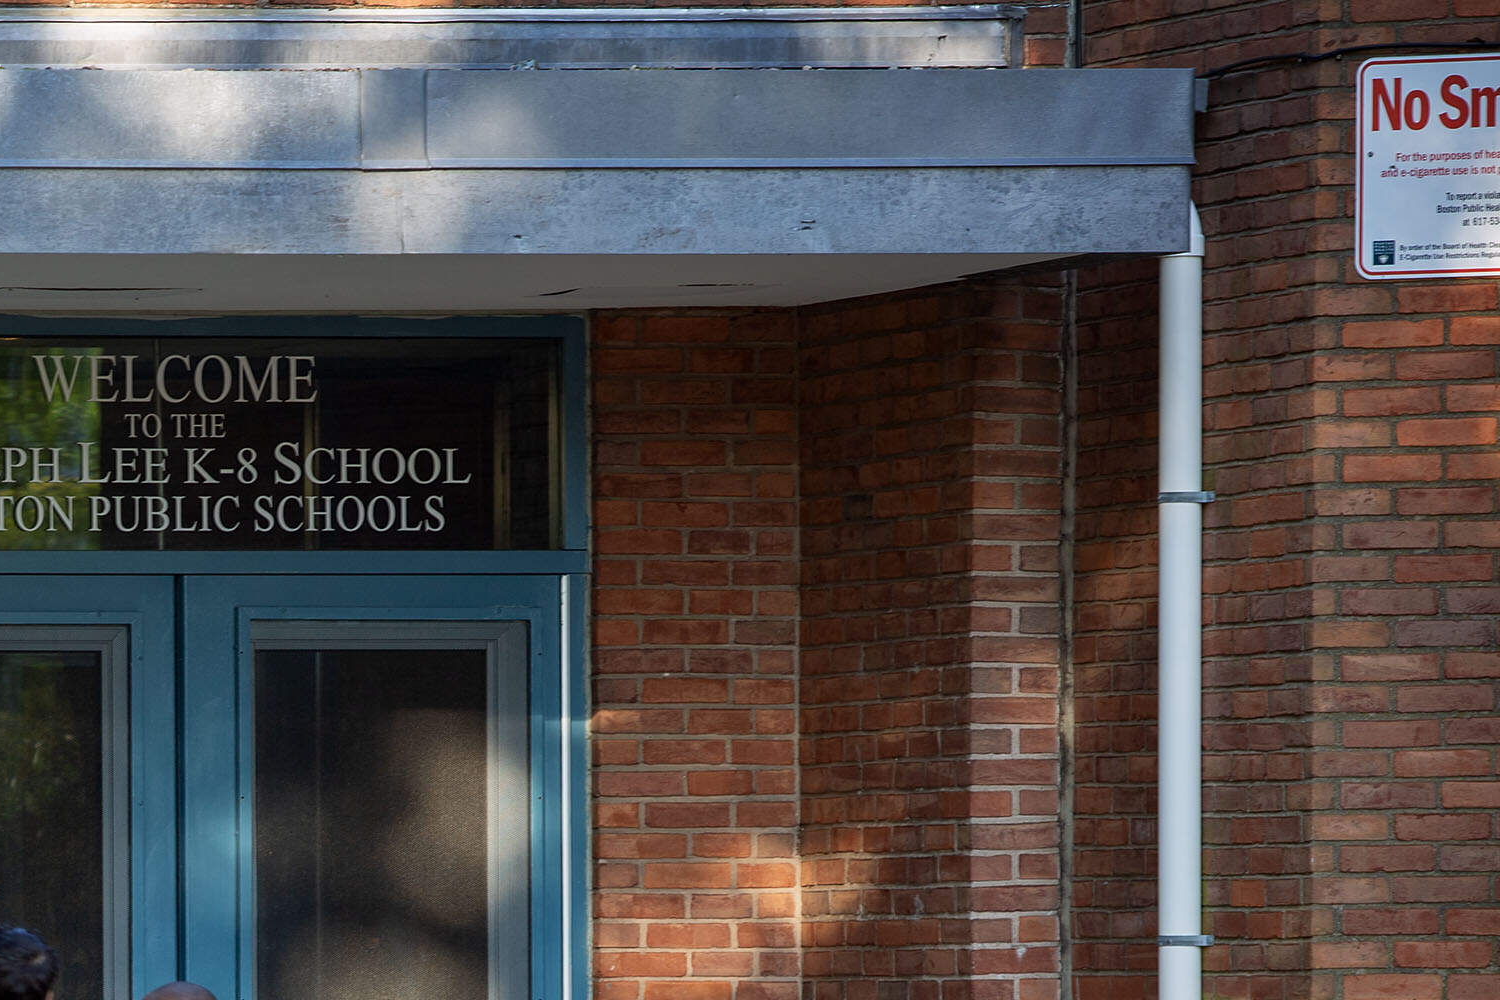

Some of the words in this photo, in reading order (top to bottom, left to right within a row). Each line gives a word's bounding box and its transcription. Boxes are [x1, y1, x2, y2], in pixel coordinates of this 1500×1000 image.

[1372, 77, 1430, 132] No
[1439, 74, 1500, 129] Sm
[1380, 168, 1398, 178] and
[1400, 167, 1450, 179] e-cigarette
[1452, 167, 1468, 176] use
[1481, 165, 1496, 175] not
[1396, 152, 1410, 162] For
[1412, 151, 1427, 161] the
[1429, 151, 1472, 163] purposes
[1474, 149, 1484, 159] of
[1437, 204, 1461, 213] Boston
[1462, 203, 1484, 213] Public
[32, 354, 318, 403] WELCOME
[124, 413, 162, 439] TO
[170, 413, 227, 438] THE
[77, 441, 171, 483] LEE
[183, 447, 258, 485] K-8
[273, 441, 472, 485] SCHOOL
[88, 494, 240, 532] PUBLIC
[253, 494, 446, 532] SCHOOLS
